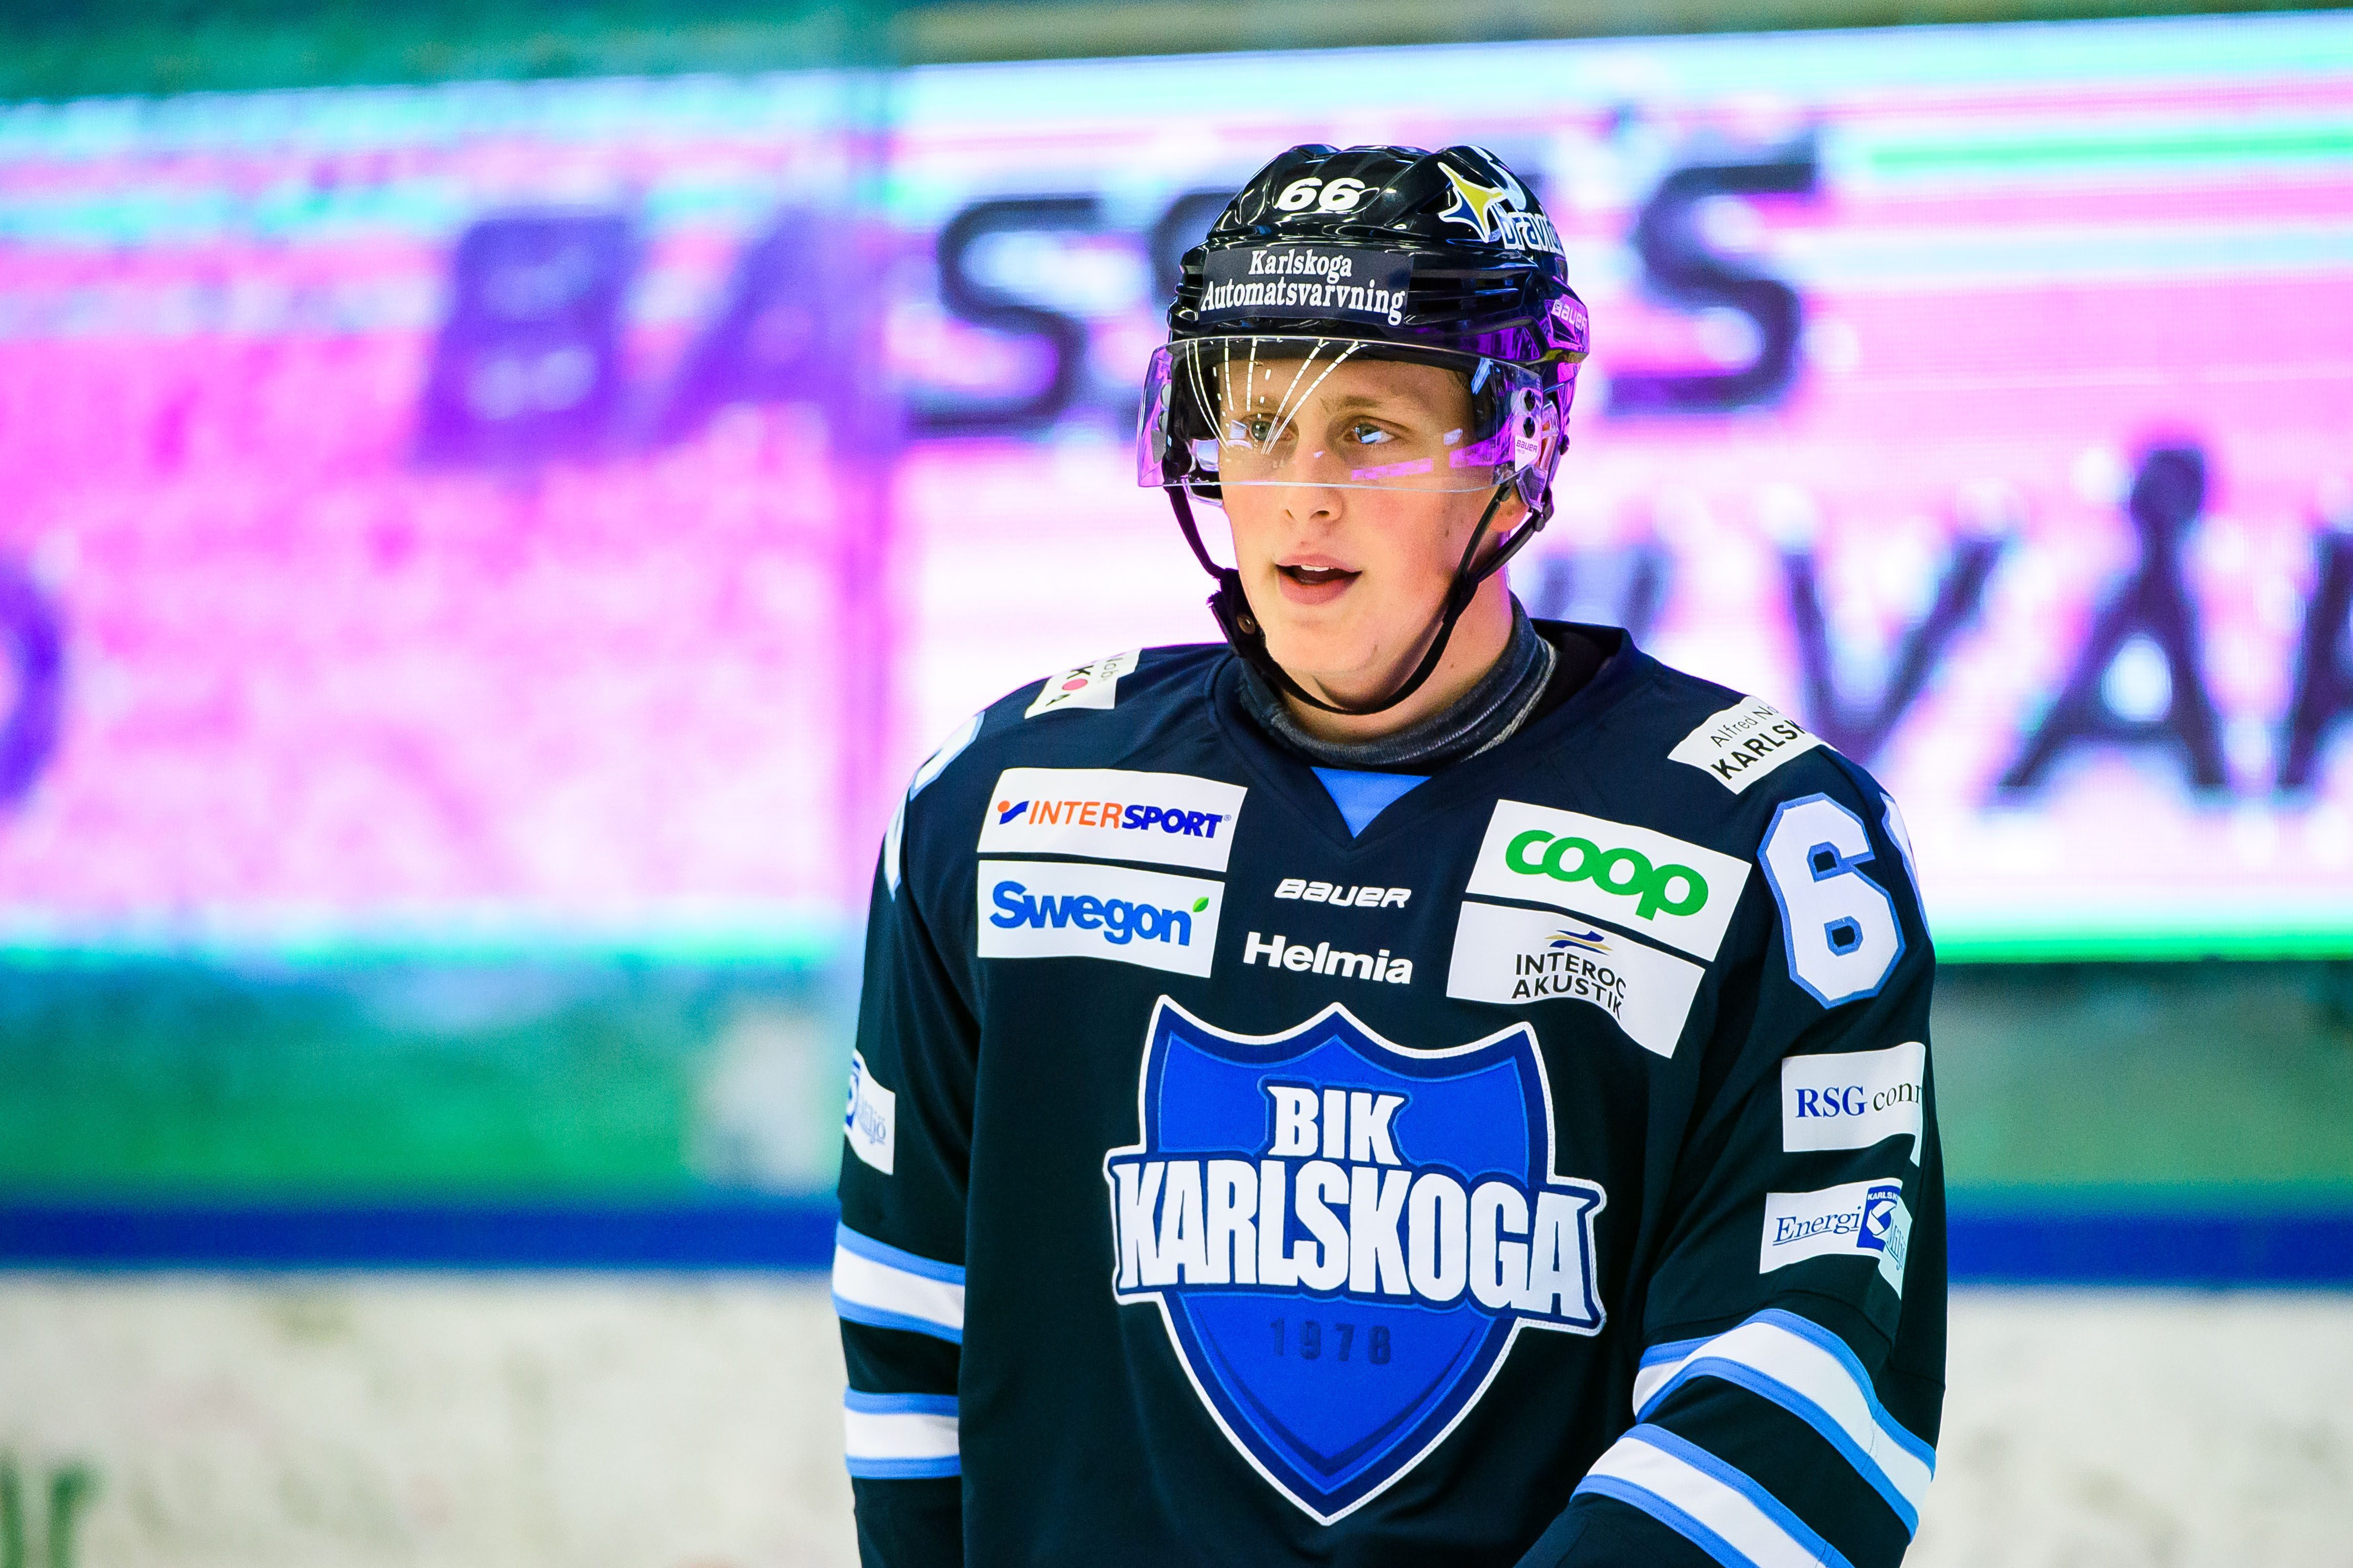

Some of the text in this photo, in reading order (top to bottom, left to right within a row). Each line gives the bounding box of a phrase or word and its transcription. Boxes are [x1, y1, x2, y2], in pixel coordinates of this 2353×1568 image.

[1278, 177, 1365, 211] 66
[1248, 248, 1352, 284] Karlskoga
[1200, 276, 1406, 326] Automatsvarvning
[1516, 439, 1538, 453] BAUER
[1710, 715, 1759, 748] Alfred
[1028, 801, 1223, 839] INTERSPORT
[1274, 878, 1412, 909] BAUER
[1505, 829, 1708, 921] coop
[989, 881, 1192, 947] Swegon
[1243, 932, 1413, 985] Helmia
[1516, 952, 1627, 1000] INTEROC
[1511, 974, 1623, 1021] AKUSTIK
[1795, 1085, 1868, 1118] RSG
[1266, 1086, 1405, 1165] BIK
[1111, 1159, 1597, 1321] KARLSKOGA
[1773, 1206, 1861, 1242] Energi
[1270, 1317, 1391, 1365] 1978
